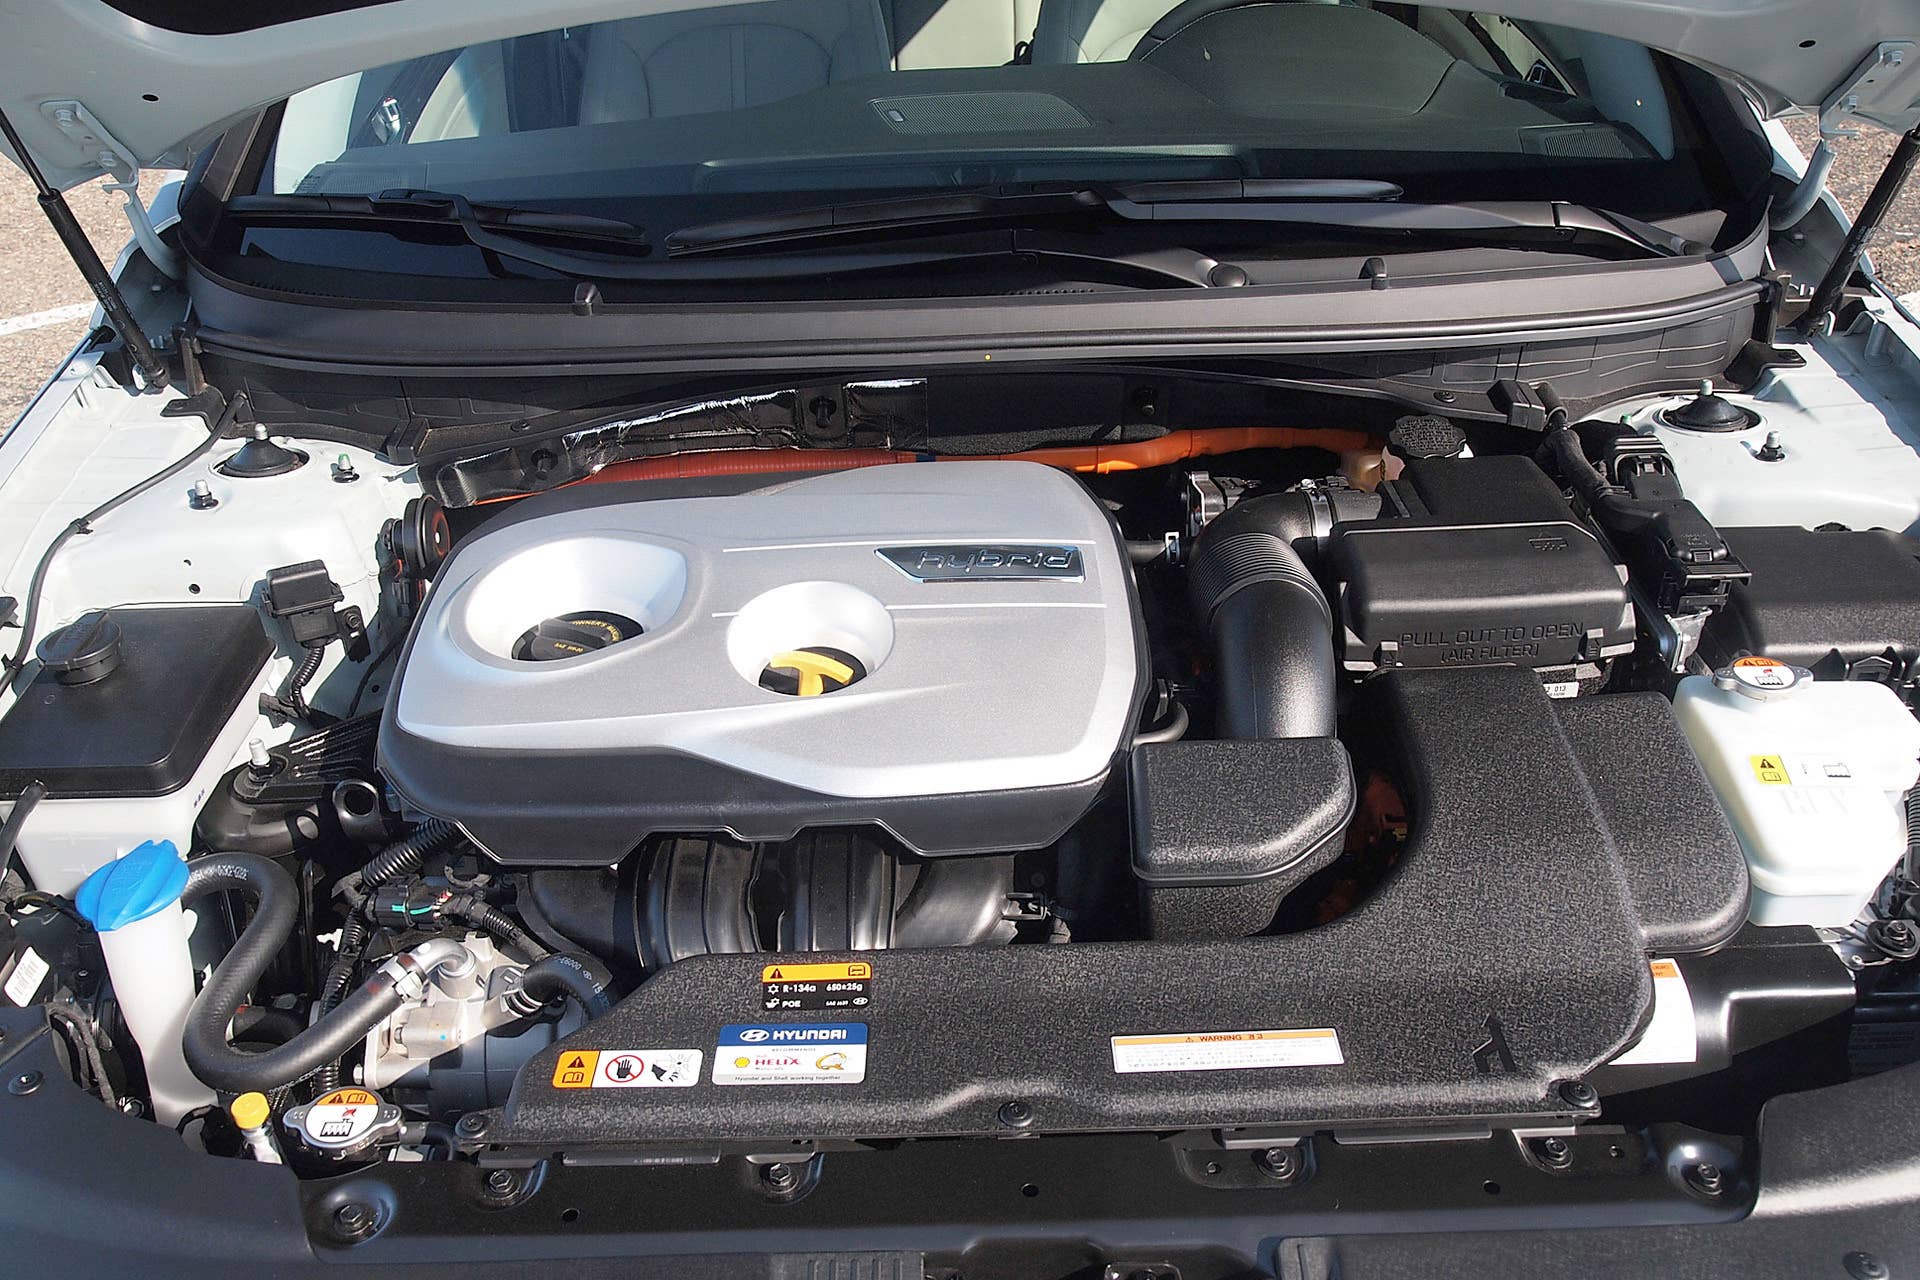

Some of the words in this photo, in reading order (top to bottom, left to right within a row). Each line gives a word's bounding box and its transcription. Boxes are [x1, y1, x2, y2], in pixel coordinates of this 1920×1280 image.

[915, 549, 1073, 572] hybrid
[1400, 632, 1449, 648] PULL
[1455, 629, 1497, 645] OUT
[1500, 627, 1525, 643] TO
[1531, 622, 1584, 640] OPEN
[782, 984, 817, 993] R-134a
[772, 1029, 848, 1041] HYUNDAI
[1199, 1034, 1242, 1042] WARNING
[754, 1057, 800, 1066] HELIX
